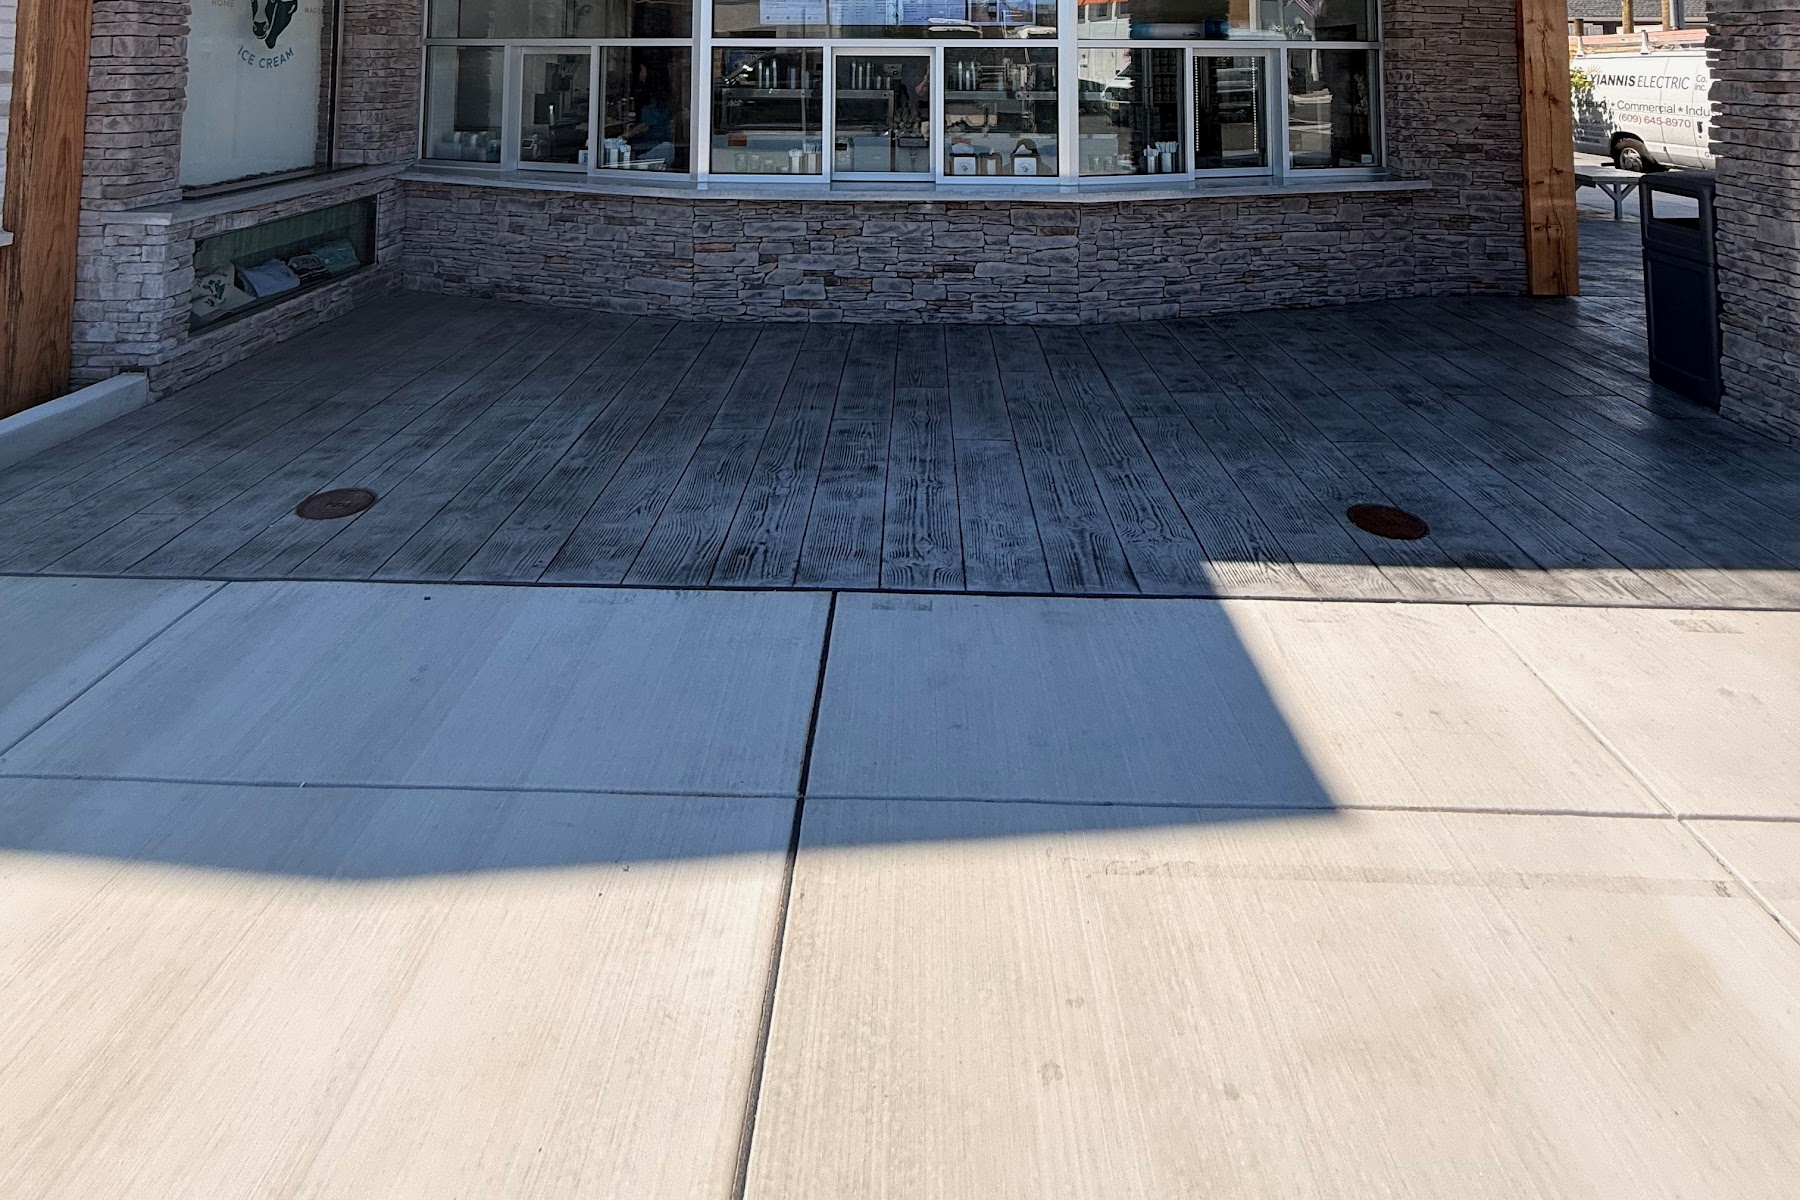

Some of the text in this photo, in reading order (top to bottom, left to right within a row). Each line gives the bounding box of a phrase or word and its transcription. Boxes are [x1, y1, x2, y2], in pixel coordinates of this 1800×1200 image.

[237, 45, 294, 69] ICE CREAM
[1591, 74, 1690, 90] YIANNIS ELECTRIC
[1696, 74, 1707, 83] Co.
[1617, 100, 1676, 114] Commercial
[1618, 113, 1691, 128] (609) 645-8970
